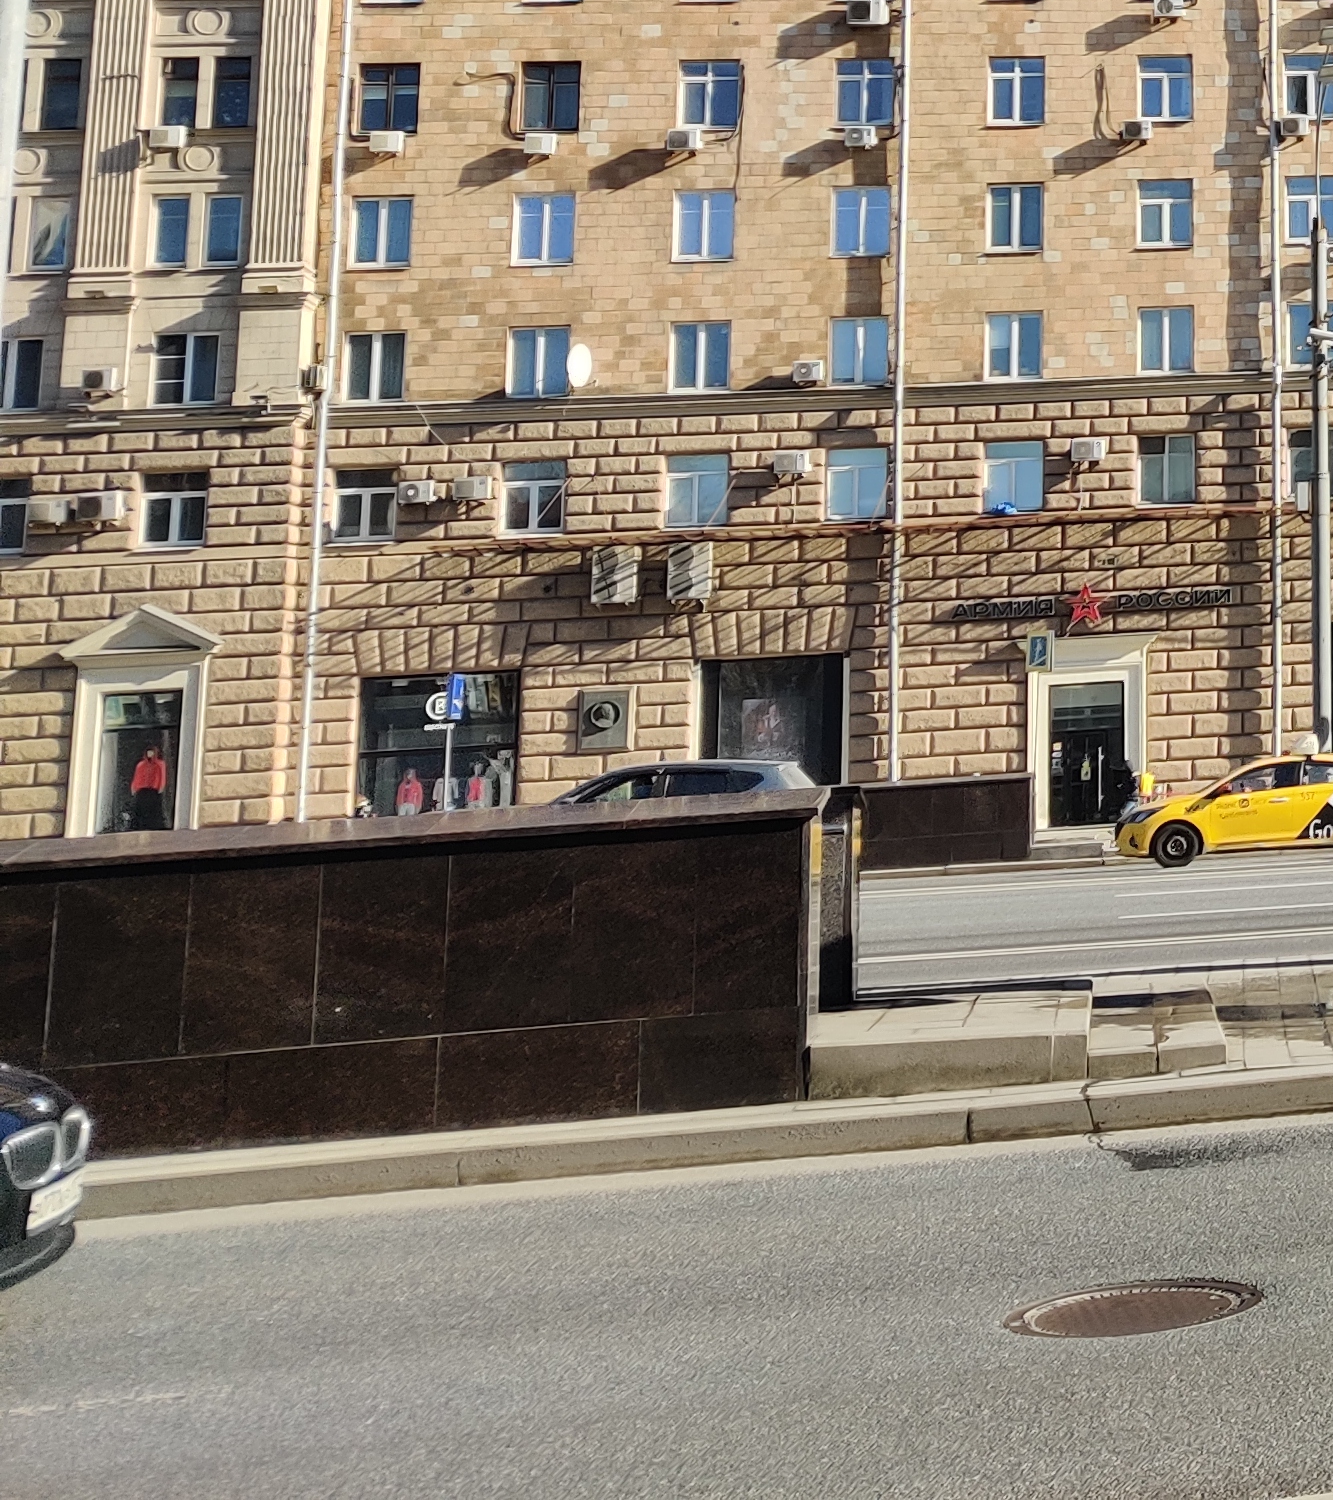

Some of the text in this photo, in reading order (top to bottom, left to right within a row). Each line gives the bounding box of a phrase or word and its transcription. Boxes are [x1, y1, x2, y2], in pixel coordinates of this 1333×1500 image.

[951, 588, 1232, 621] АРМИЯ РОССИИ
[1308, 818, 1333, 839] Go
